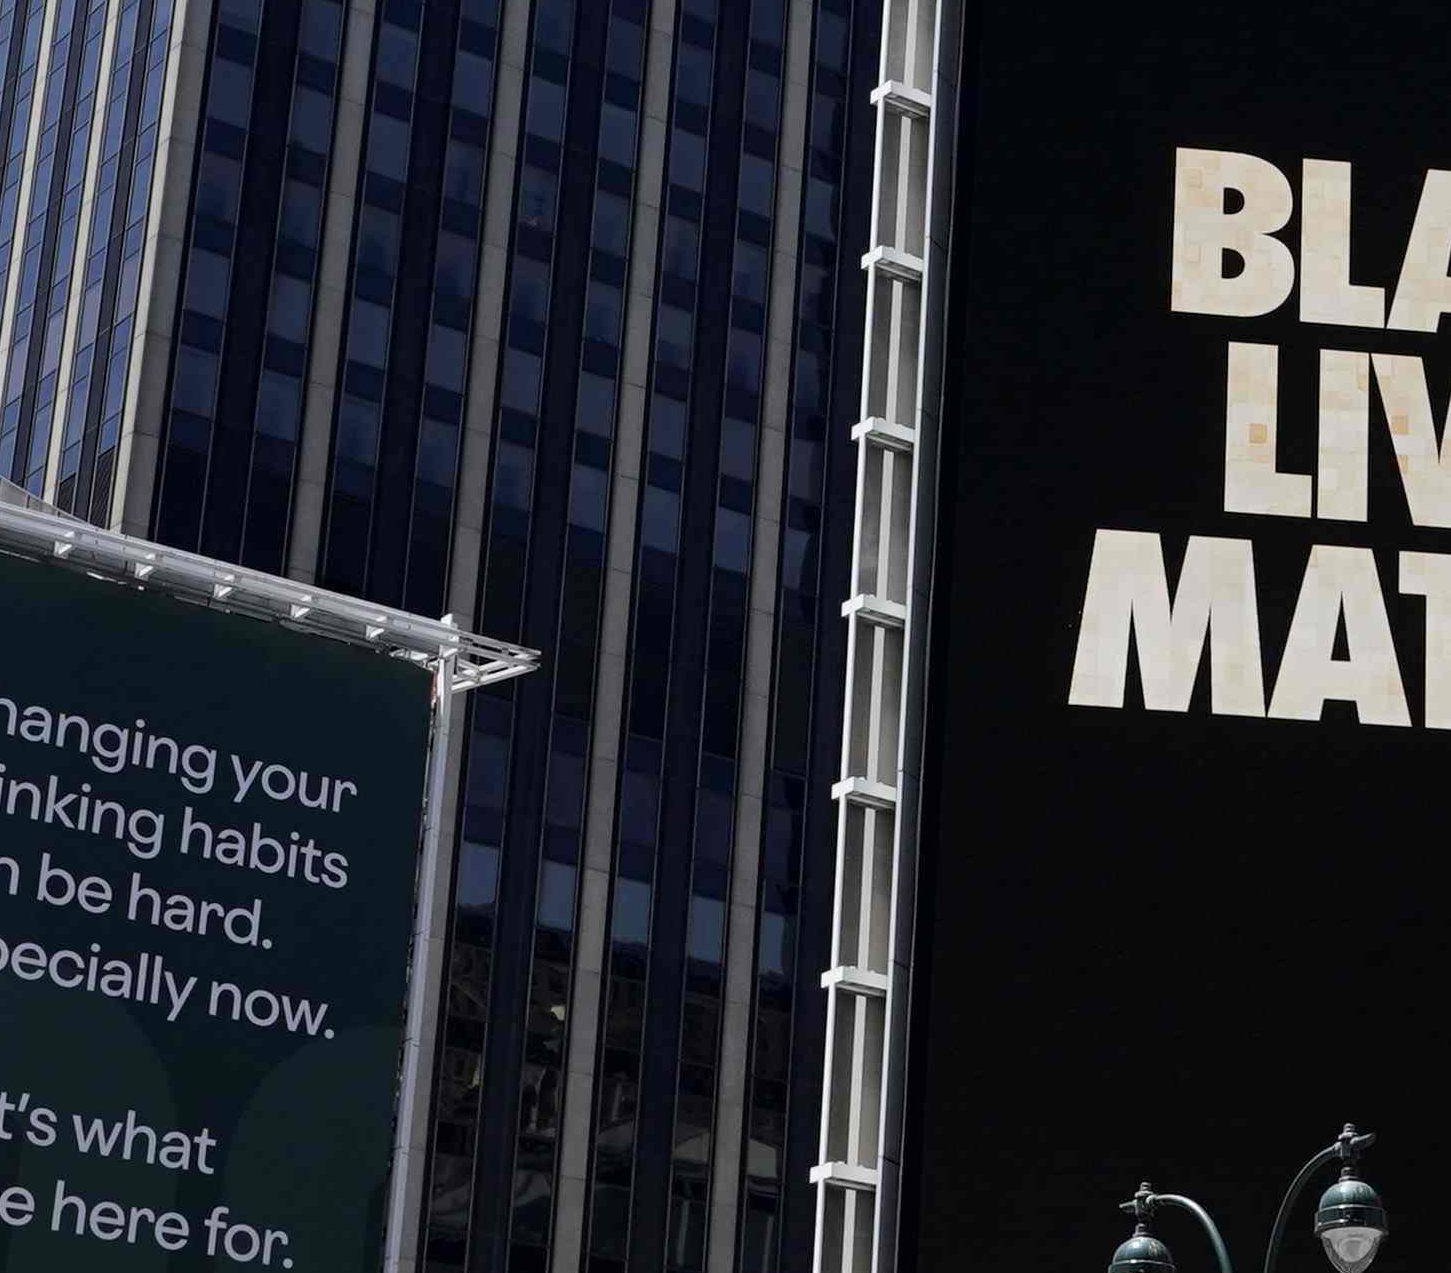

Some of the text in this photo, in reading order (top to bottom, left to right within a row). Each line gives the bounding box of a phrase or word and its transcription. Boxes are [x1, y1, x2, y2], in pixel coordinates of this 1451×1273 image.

[232, 753, 357, 814] your
[182, 807, 349, 889] habits
[38, 853, 111, 913] be
[129, 874, 273, 949] hard.
[210, 981, 335, 1039] now.
[74, 1109, 216, 1175] what
[52, 1181, 188, 1251] here
[205, 1206, 294, 1269] for.
